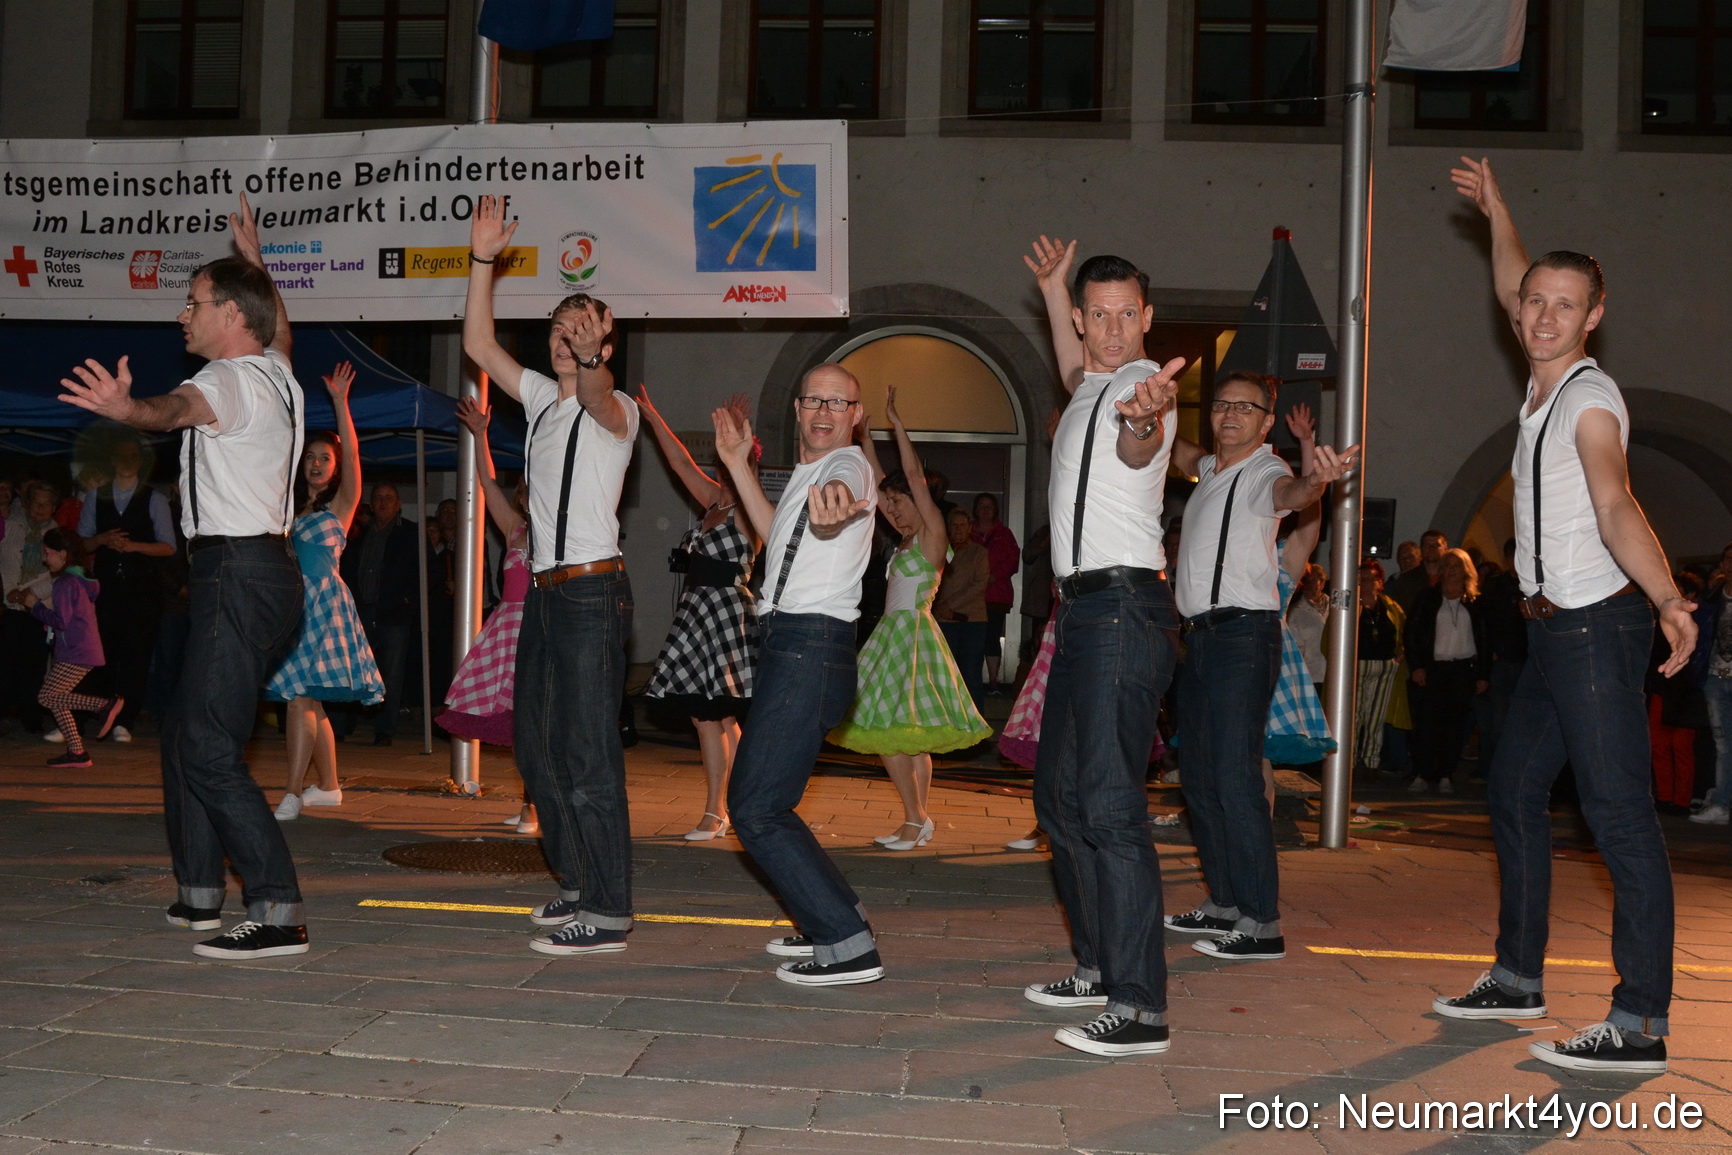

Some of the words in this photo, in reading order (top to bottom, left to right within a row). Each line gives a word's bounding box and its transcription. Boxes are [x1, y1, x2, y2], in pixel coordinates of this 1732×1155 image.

[4, 167, 233, 203] tsgemeinschaft
[245, 166, 342, 194] offene
[354, 154, 645, 188] Behindertenarbeit
[32, 209, 68, 234] im
[80, 208, 229, 235] Landkreis
[253, 196, 386, 229] eumarkt
[44, 246, 125, 260] Bayerisches
[162, 249, 204, 260] Caritas-
[259, 241, 307, 255] akonie
[44, 261, 81, 273] Rotes
[264, 259, 326, 274] rnberger
[330, 259, 364, 271] Land
[412, 253, 464, 274] Regens
[47, 275, 84, 288] Kreuz
[132, 280, 157, 289] caritas
[159, 277, 192, 289] Neum
[273, 277, 315, 289] markt
